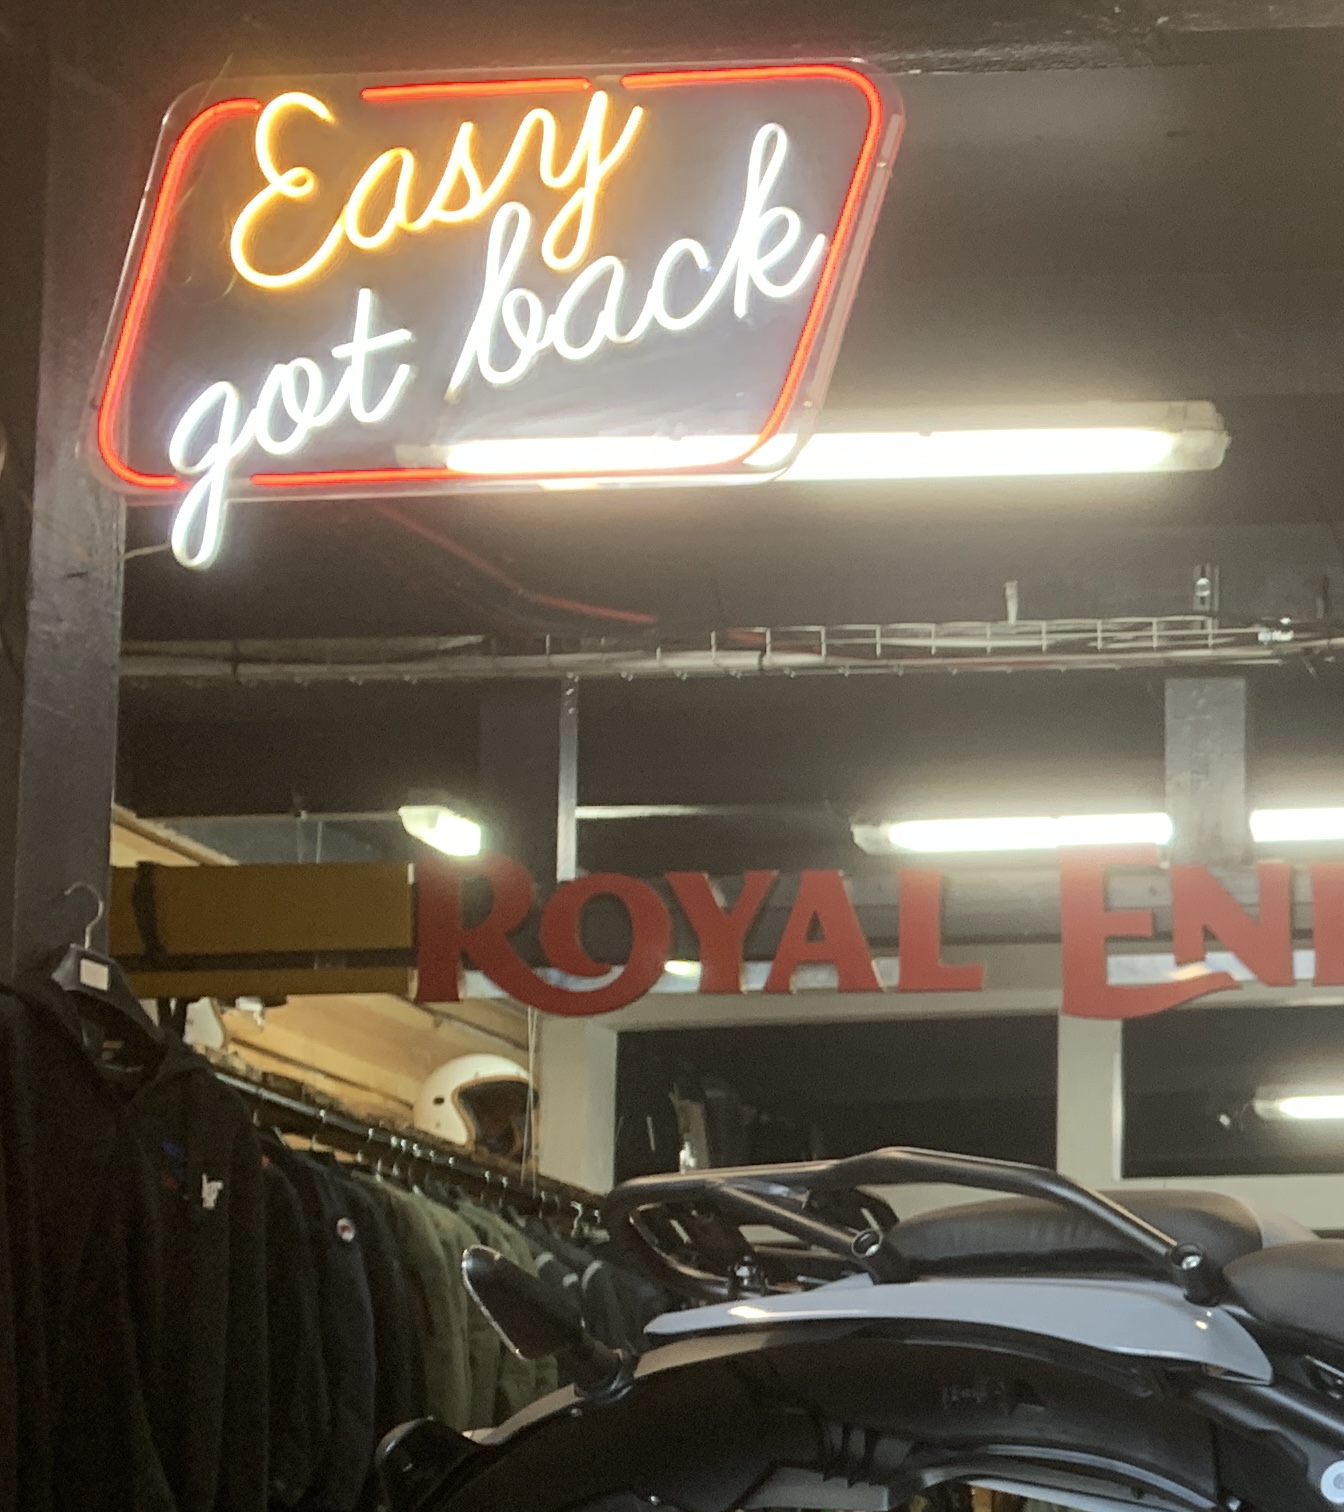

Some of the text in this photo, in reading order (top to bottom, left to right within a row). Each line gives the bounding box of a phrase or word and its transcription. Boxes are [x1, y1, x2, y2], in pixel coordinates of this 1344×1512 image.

[229, 90, 644, 289] Easy
[168, 122, 828, 570] got back
[414, 853, 986, 1017] ROYAL
